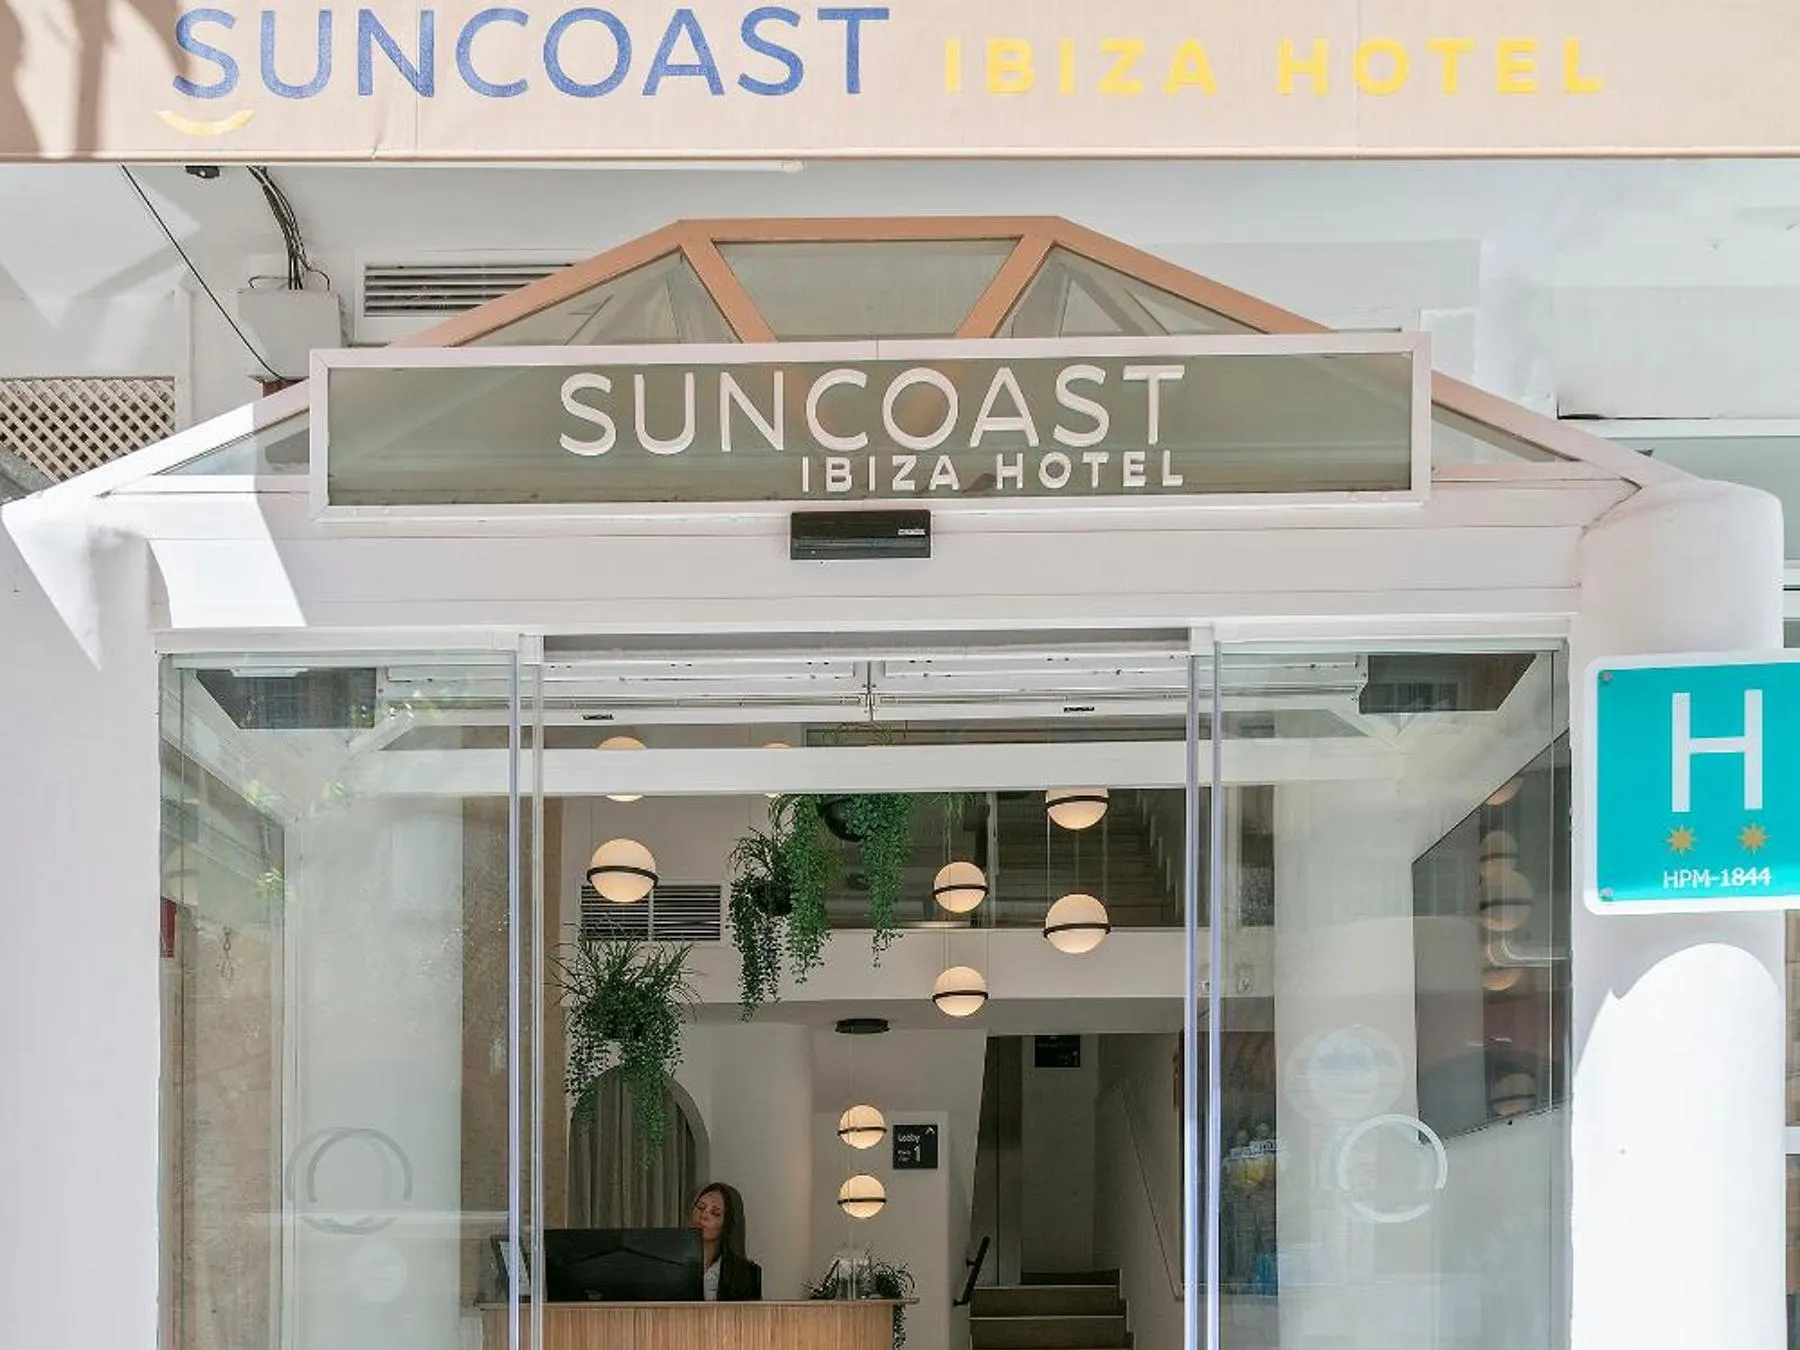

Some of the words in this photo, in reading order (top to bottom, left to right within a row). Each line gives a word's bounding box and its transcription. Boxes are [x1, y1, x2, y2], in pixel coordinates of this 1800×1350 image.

[172, 7, 889, 98] SUNCOAST
[944, 37, 1217, 95] IBIZA
[1277, 37, 1604, 95] HOTEL
[559, 364, 1186, 457] SUNCOAST
[802, 454, 961, 493] IBIZA
[996, 450, 1184, 490] HOTEL
[1671, 689, 1763, 813] H
[1663, 867, 1772, 889] HPM-1844
